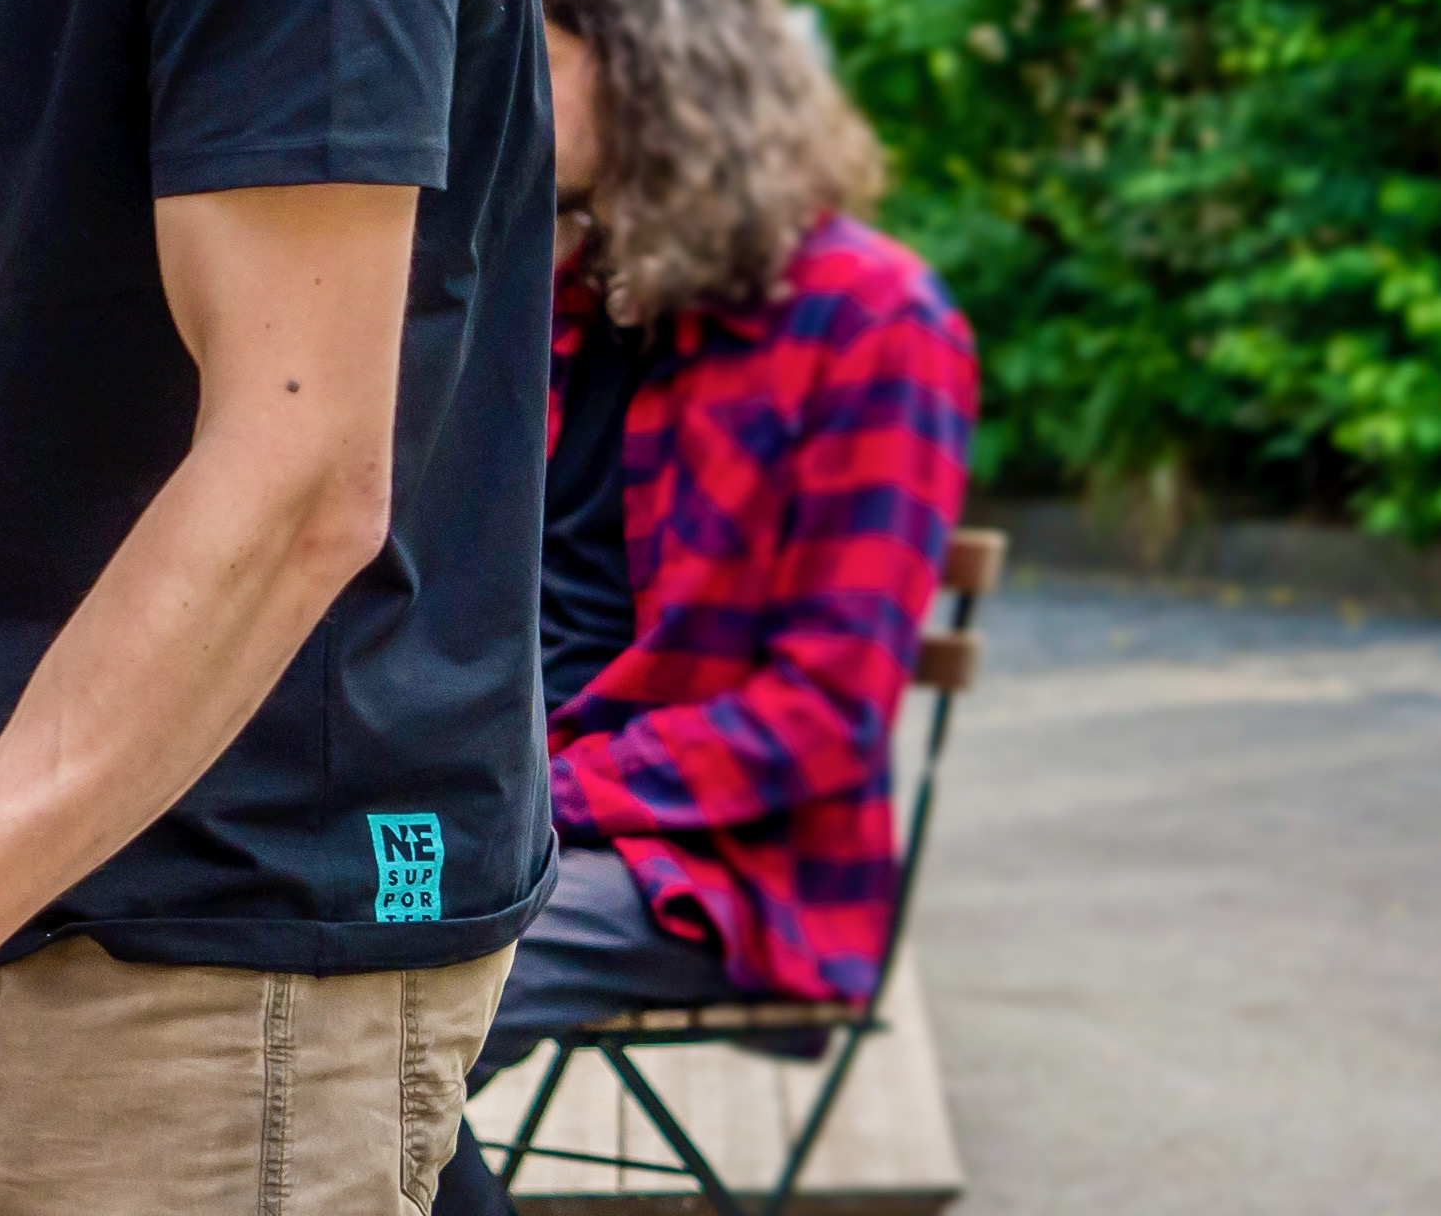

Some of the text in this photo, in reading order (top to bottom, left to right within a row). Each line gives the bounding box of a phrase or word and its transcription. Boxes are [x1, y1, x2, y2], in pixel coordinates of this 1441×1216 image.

[380, 824, 436, 862] NE
[388, 868, 433, 886] SUP
[383, 891, 432, 908] POR
